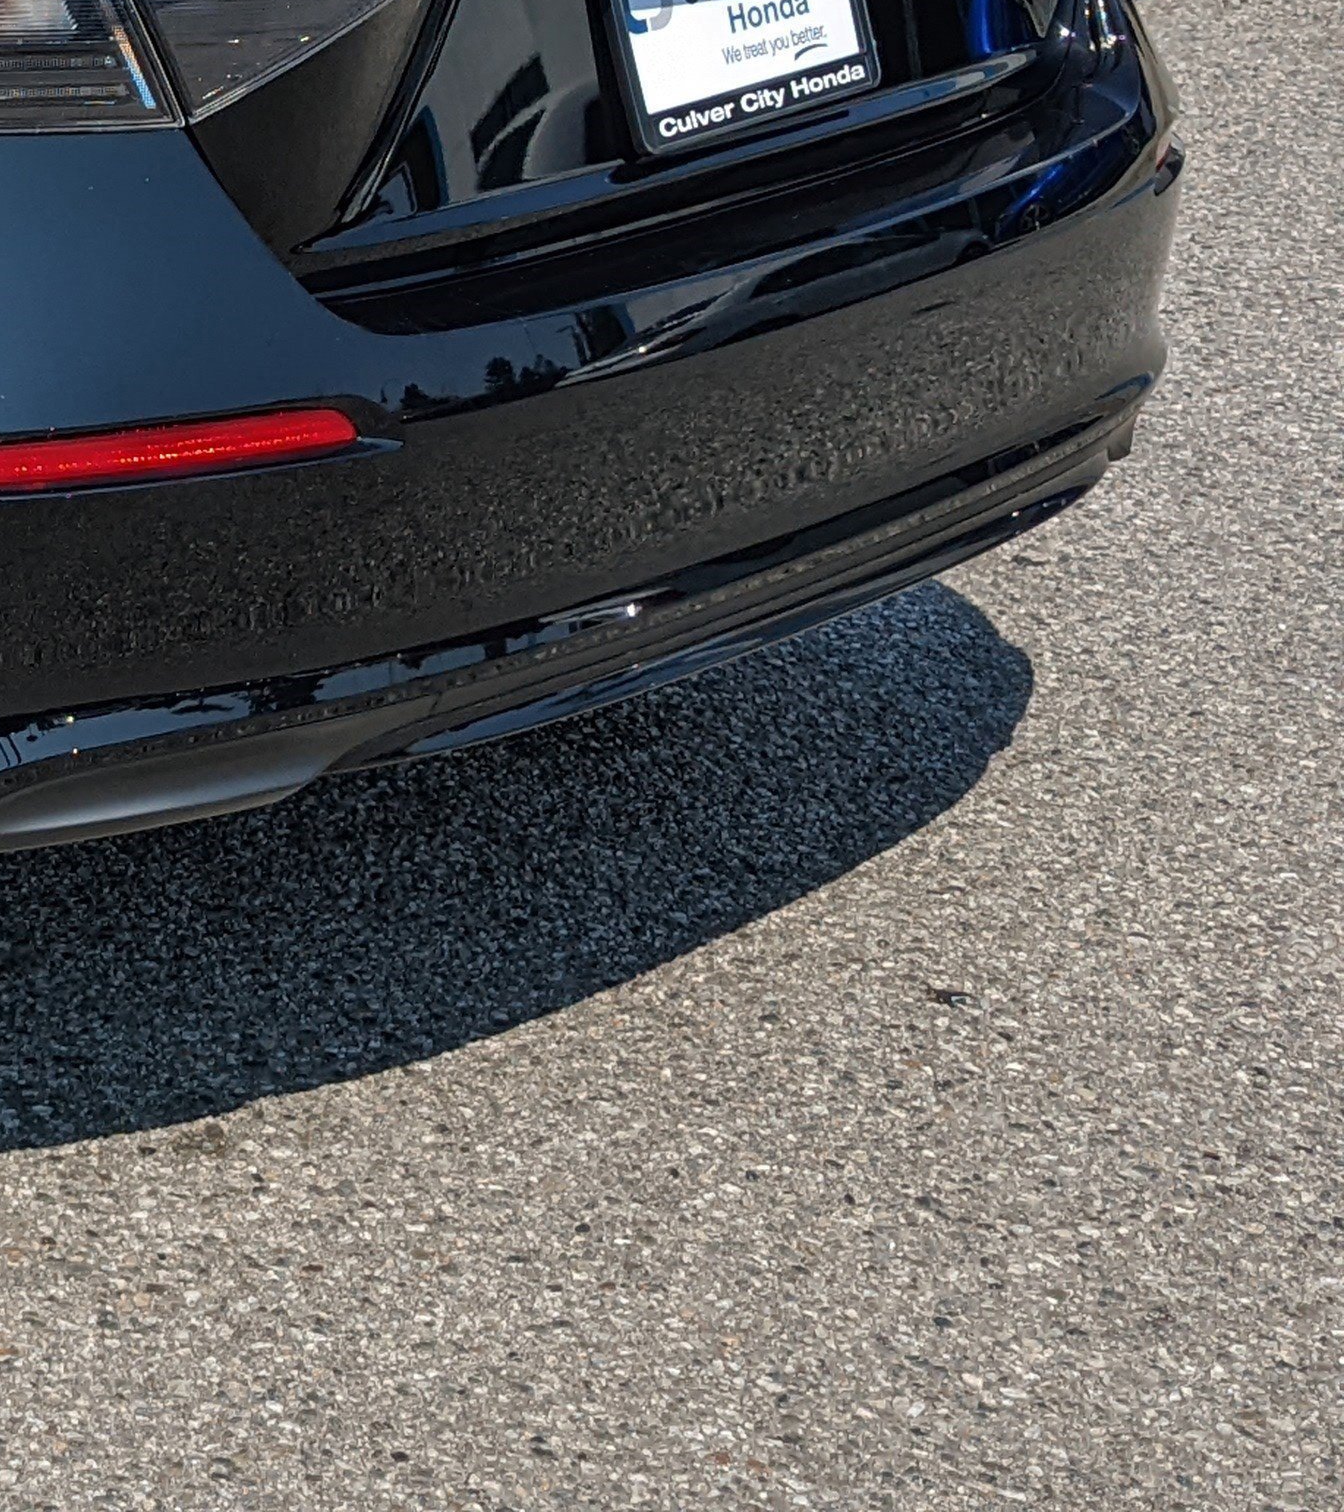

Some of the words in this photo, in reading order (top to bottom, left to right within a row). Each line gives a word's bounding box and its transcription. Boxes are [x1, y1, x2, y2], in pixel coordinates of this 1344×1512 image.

[722, 47, 743, 65] We
[742, 41, 768, 60] treat
[770, 36, 790, 57] you
[659, 103, 735, 138] Culver
[740, 86, 786, 114] City
[790, 63, 866, 99] Honda
